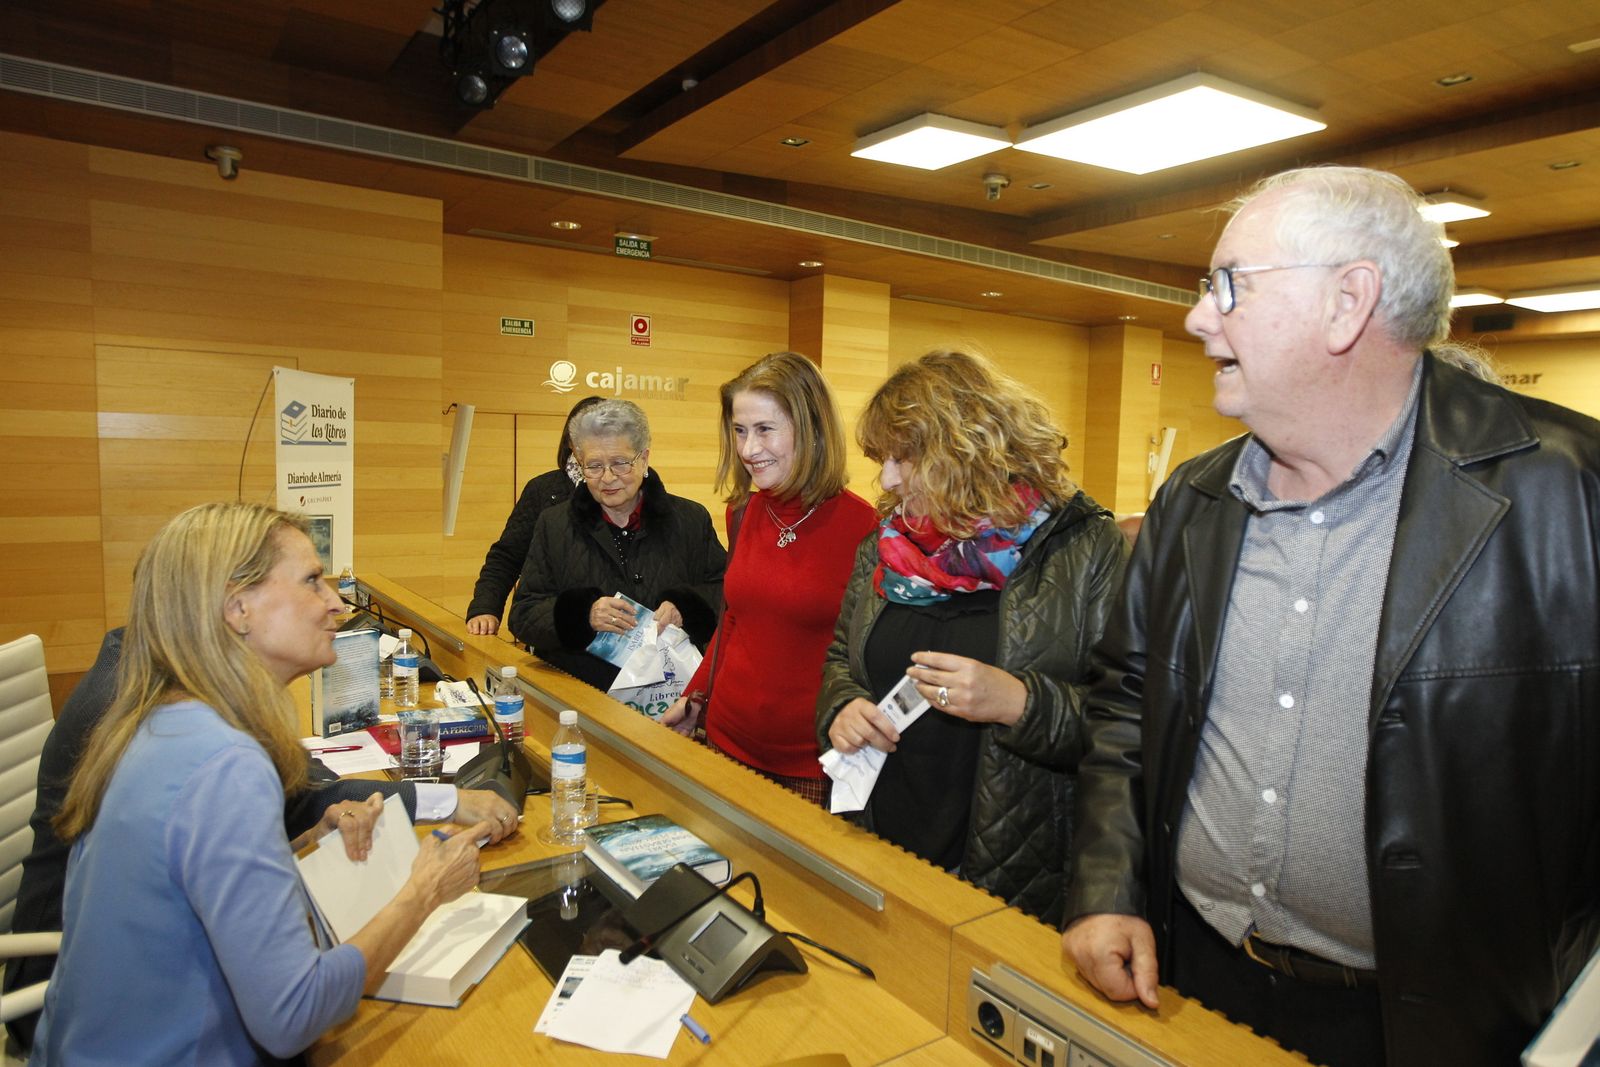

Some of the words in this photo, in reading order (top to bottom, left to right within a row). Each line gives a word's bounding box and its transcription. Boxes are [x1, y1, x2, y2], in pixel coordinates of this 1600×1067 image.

[618, 239, 638, 249] SALIDA
[640, 242, 648, 250] DE
[616, 246, 650, 258] EMERGENCIA
[504, 319, 521, 327] SALIDA
[503, 326, 532, 335] EMERGENCIA
[585, 366, 689, 396] cajamar
[1500, 373, 1543, 385] mar
[311, 404, 337, 419] Diario
[338, 407, 347, 420] de
[311, 423, 323, 439] los
[324, 423, 347, 443] Libros
[287, 472, 309, 484] Diario
[309, 471, 318, 483] de
[318, 469, 342, 482] Almería
[450, 724, 488, 735] PEREGRIN
